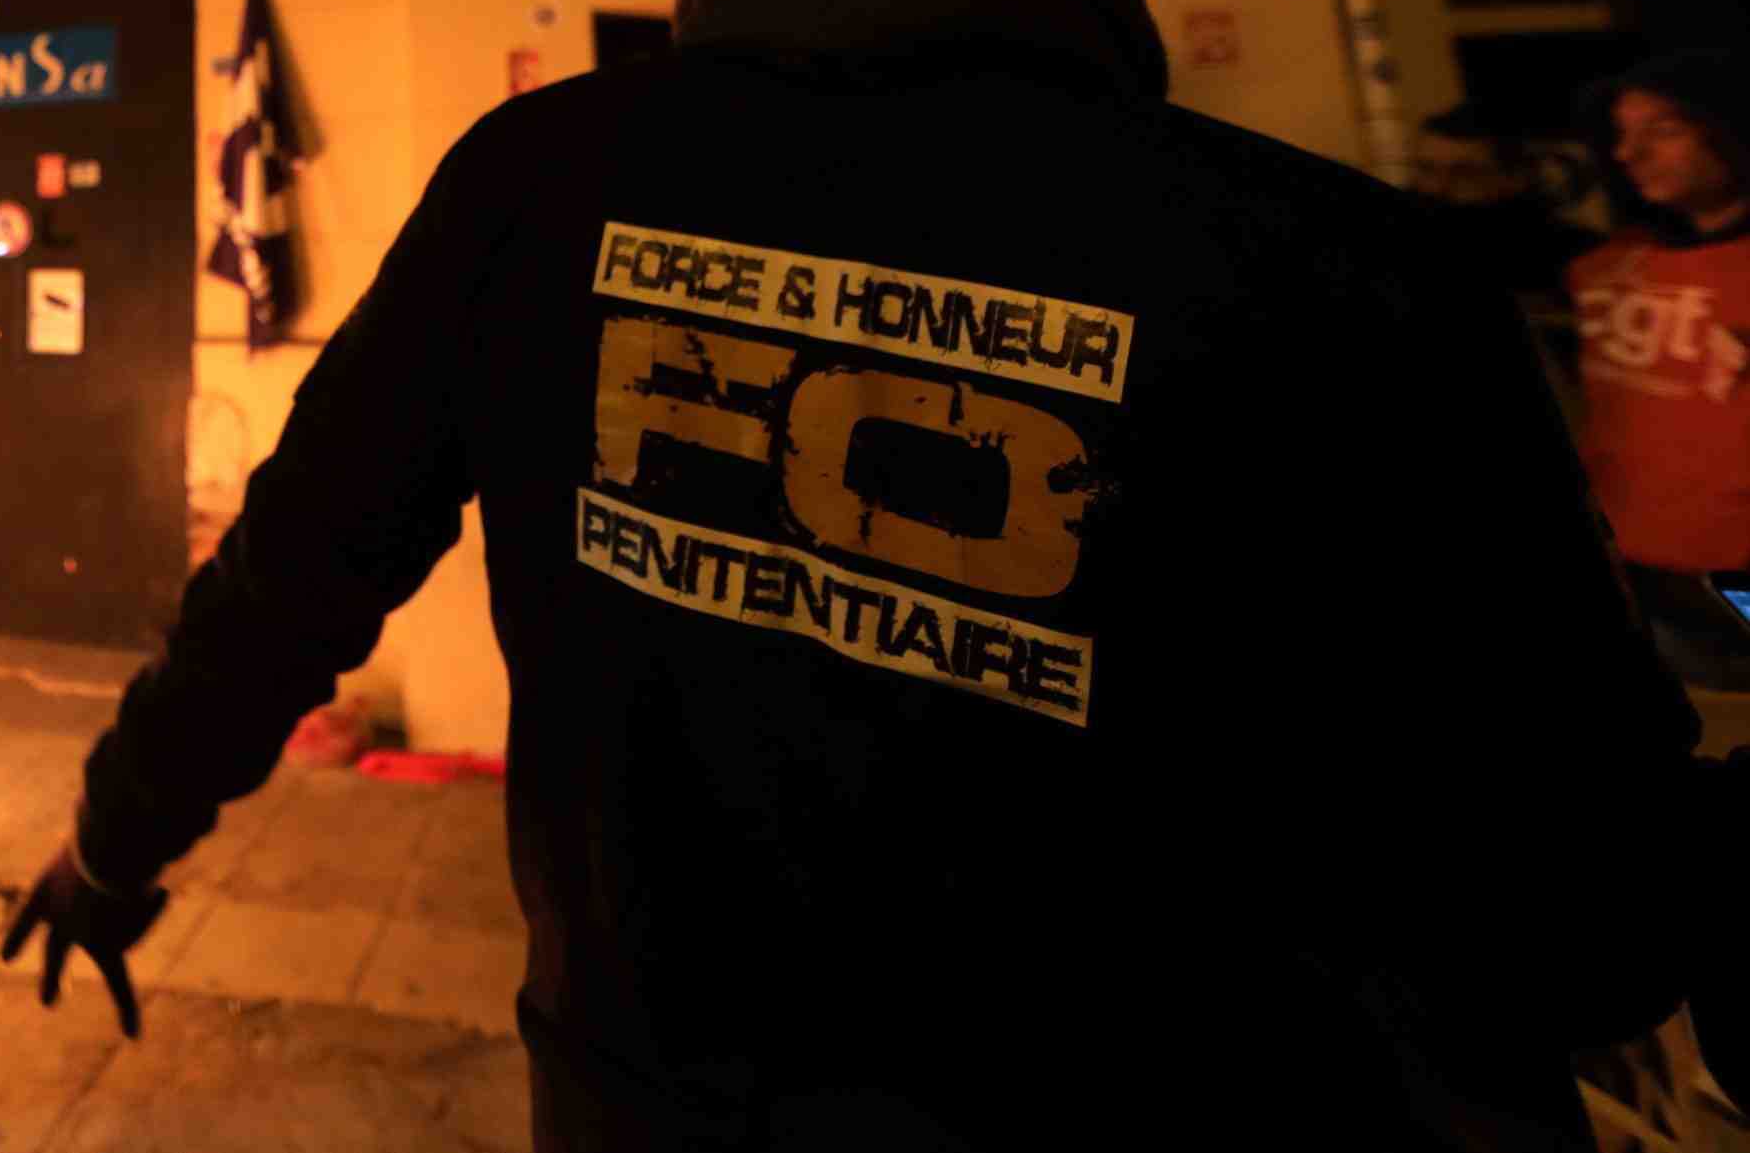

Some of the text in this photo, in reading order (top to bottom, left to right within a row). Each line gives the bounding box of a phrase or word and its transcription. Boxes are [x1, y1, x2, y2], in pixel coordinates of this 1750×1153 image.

[603, 233, 1120, 389] FORCE & HONNEUR
[592, 312, 1090, 600] FO
[582, 498, 1084, 714] PENITENTIAIRE
